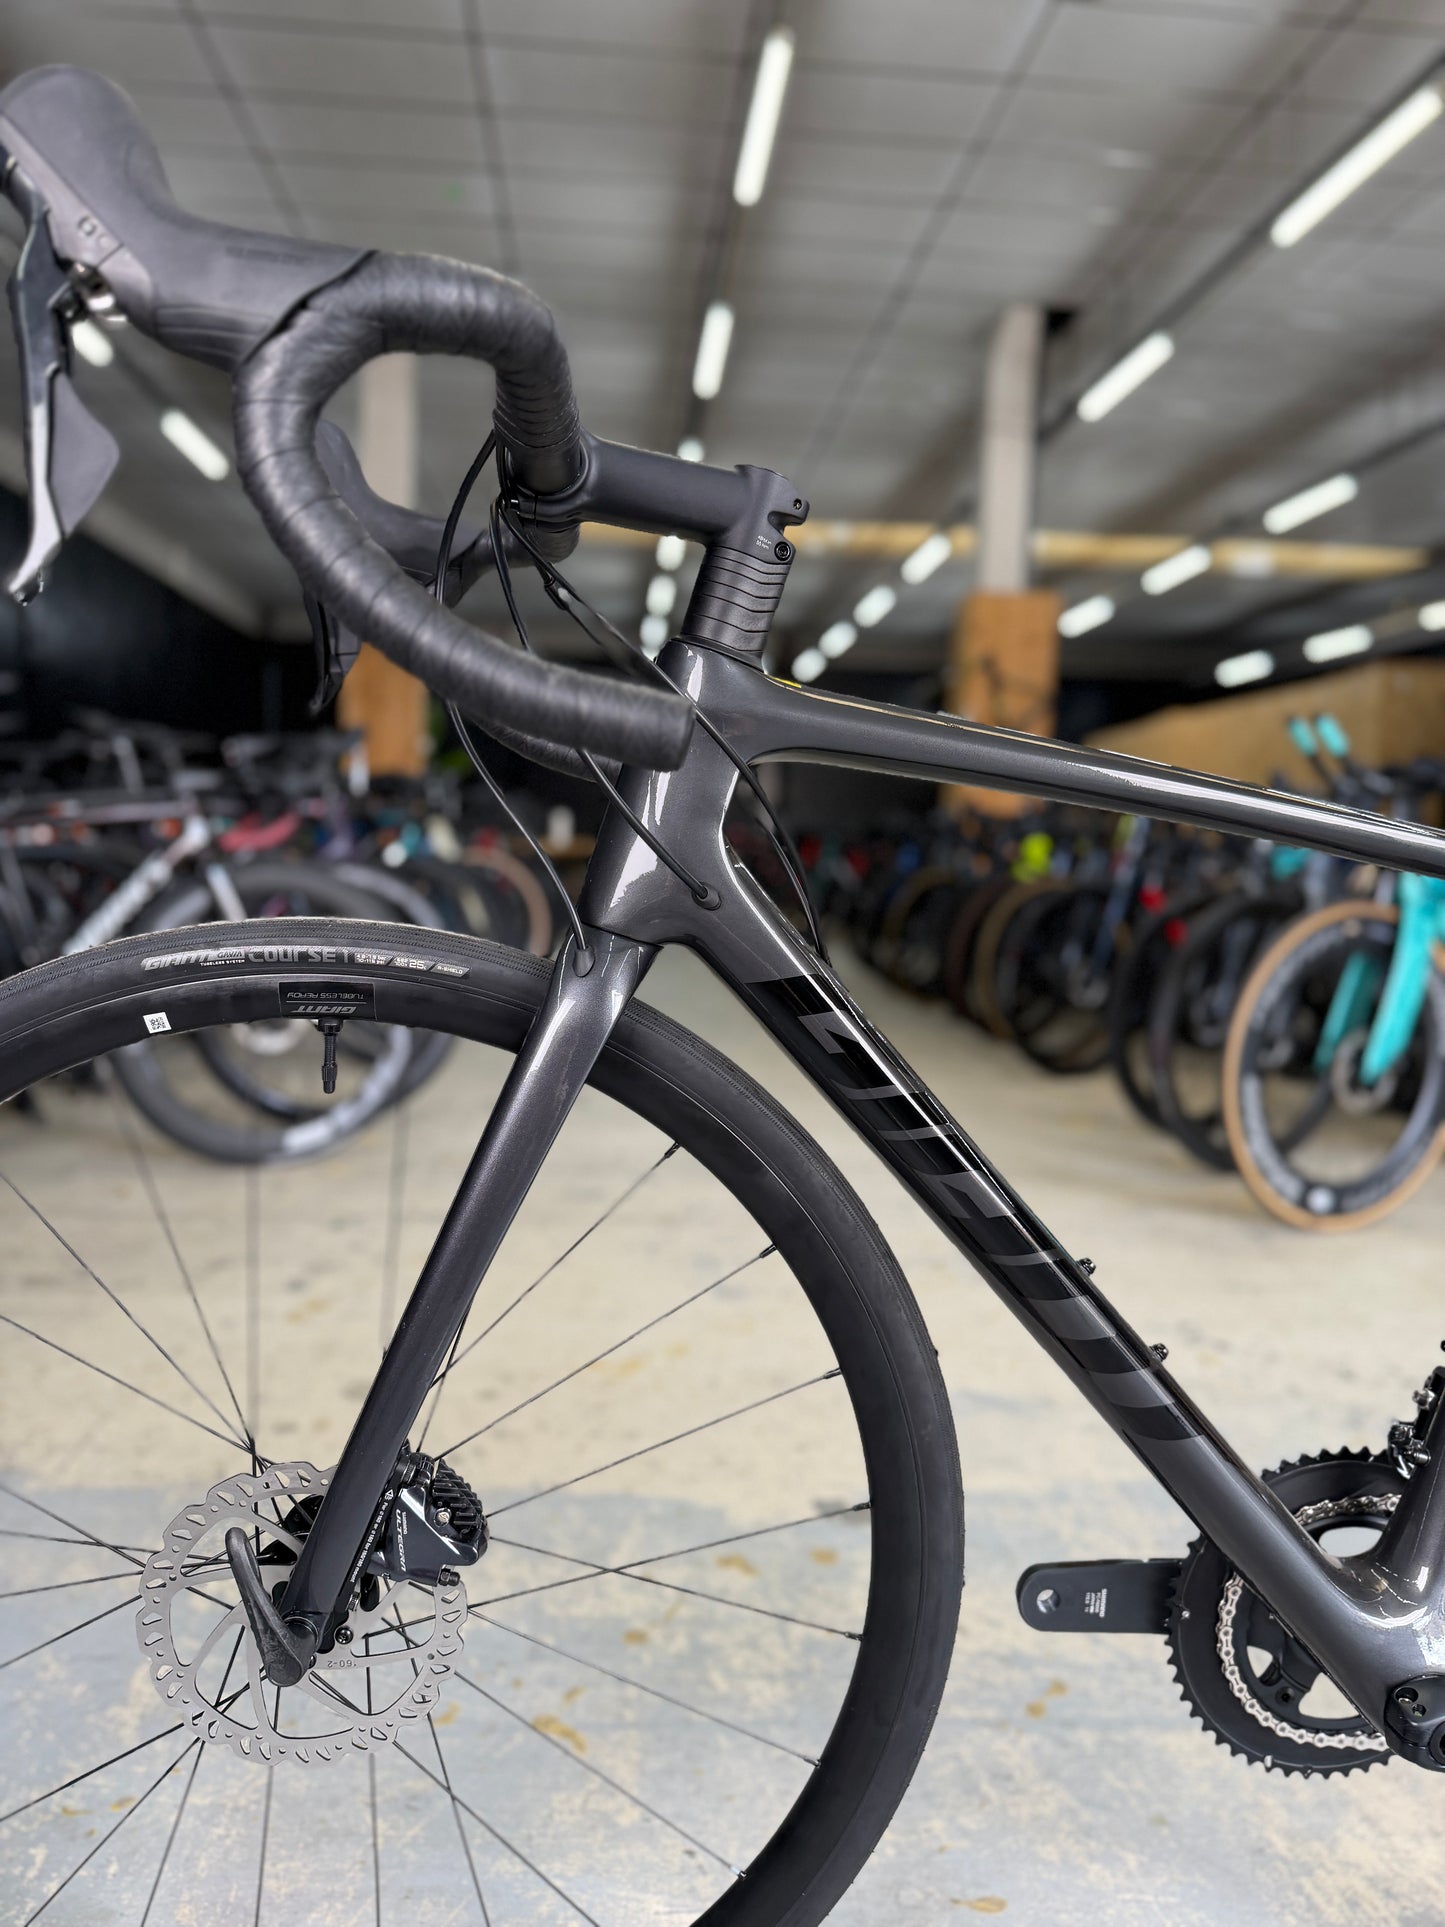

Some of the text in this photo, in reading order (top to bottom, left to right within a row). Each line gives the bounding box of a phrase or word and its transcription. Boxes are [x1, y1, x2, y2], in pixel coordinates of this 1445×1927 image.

[140, 949, 213, 971] GIANT
[217, 951, 243, 959] GAVIA
[249, 947, 336, 962] COURSE
[320, 992, 364, 1000] TUBELESS
[290, 1005, 357, 1014] GIANT
[395, 1508, 406, 1572] ULTEGRA
[350, 1567, 359, 1583] mount
